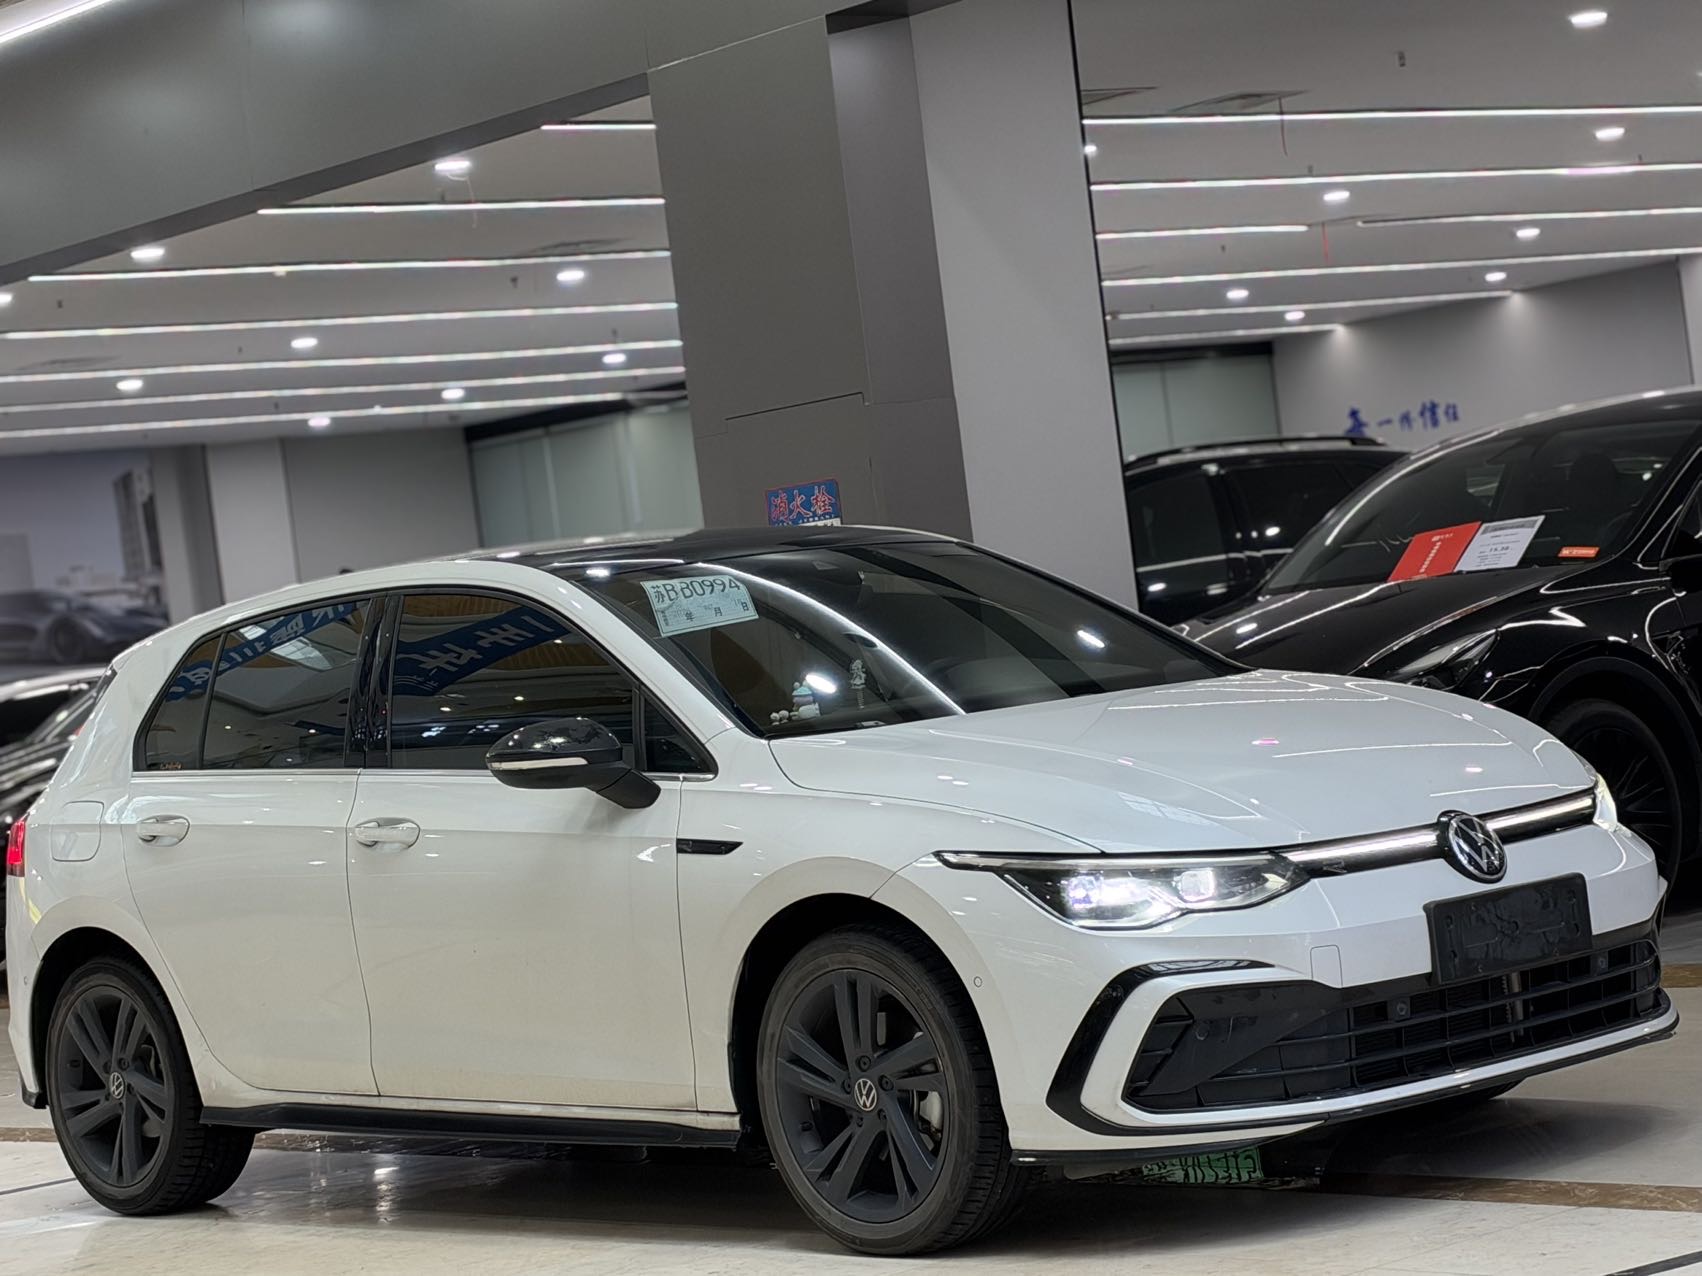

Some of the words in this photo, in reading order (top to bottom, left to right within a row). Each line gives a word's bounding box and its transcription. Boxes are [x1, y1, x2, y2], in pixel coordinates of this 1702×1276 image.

[770, 485, 836, 523] 消火栓
[713, 606, 724, 617] 月
[740, 601, 750, 612] 日
